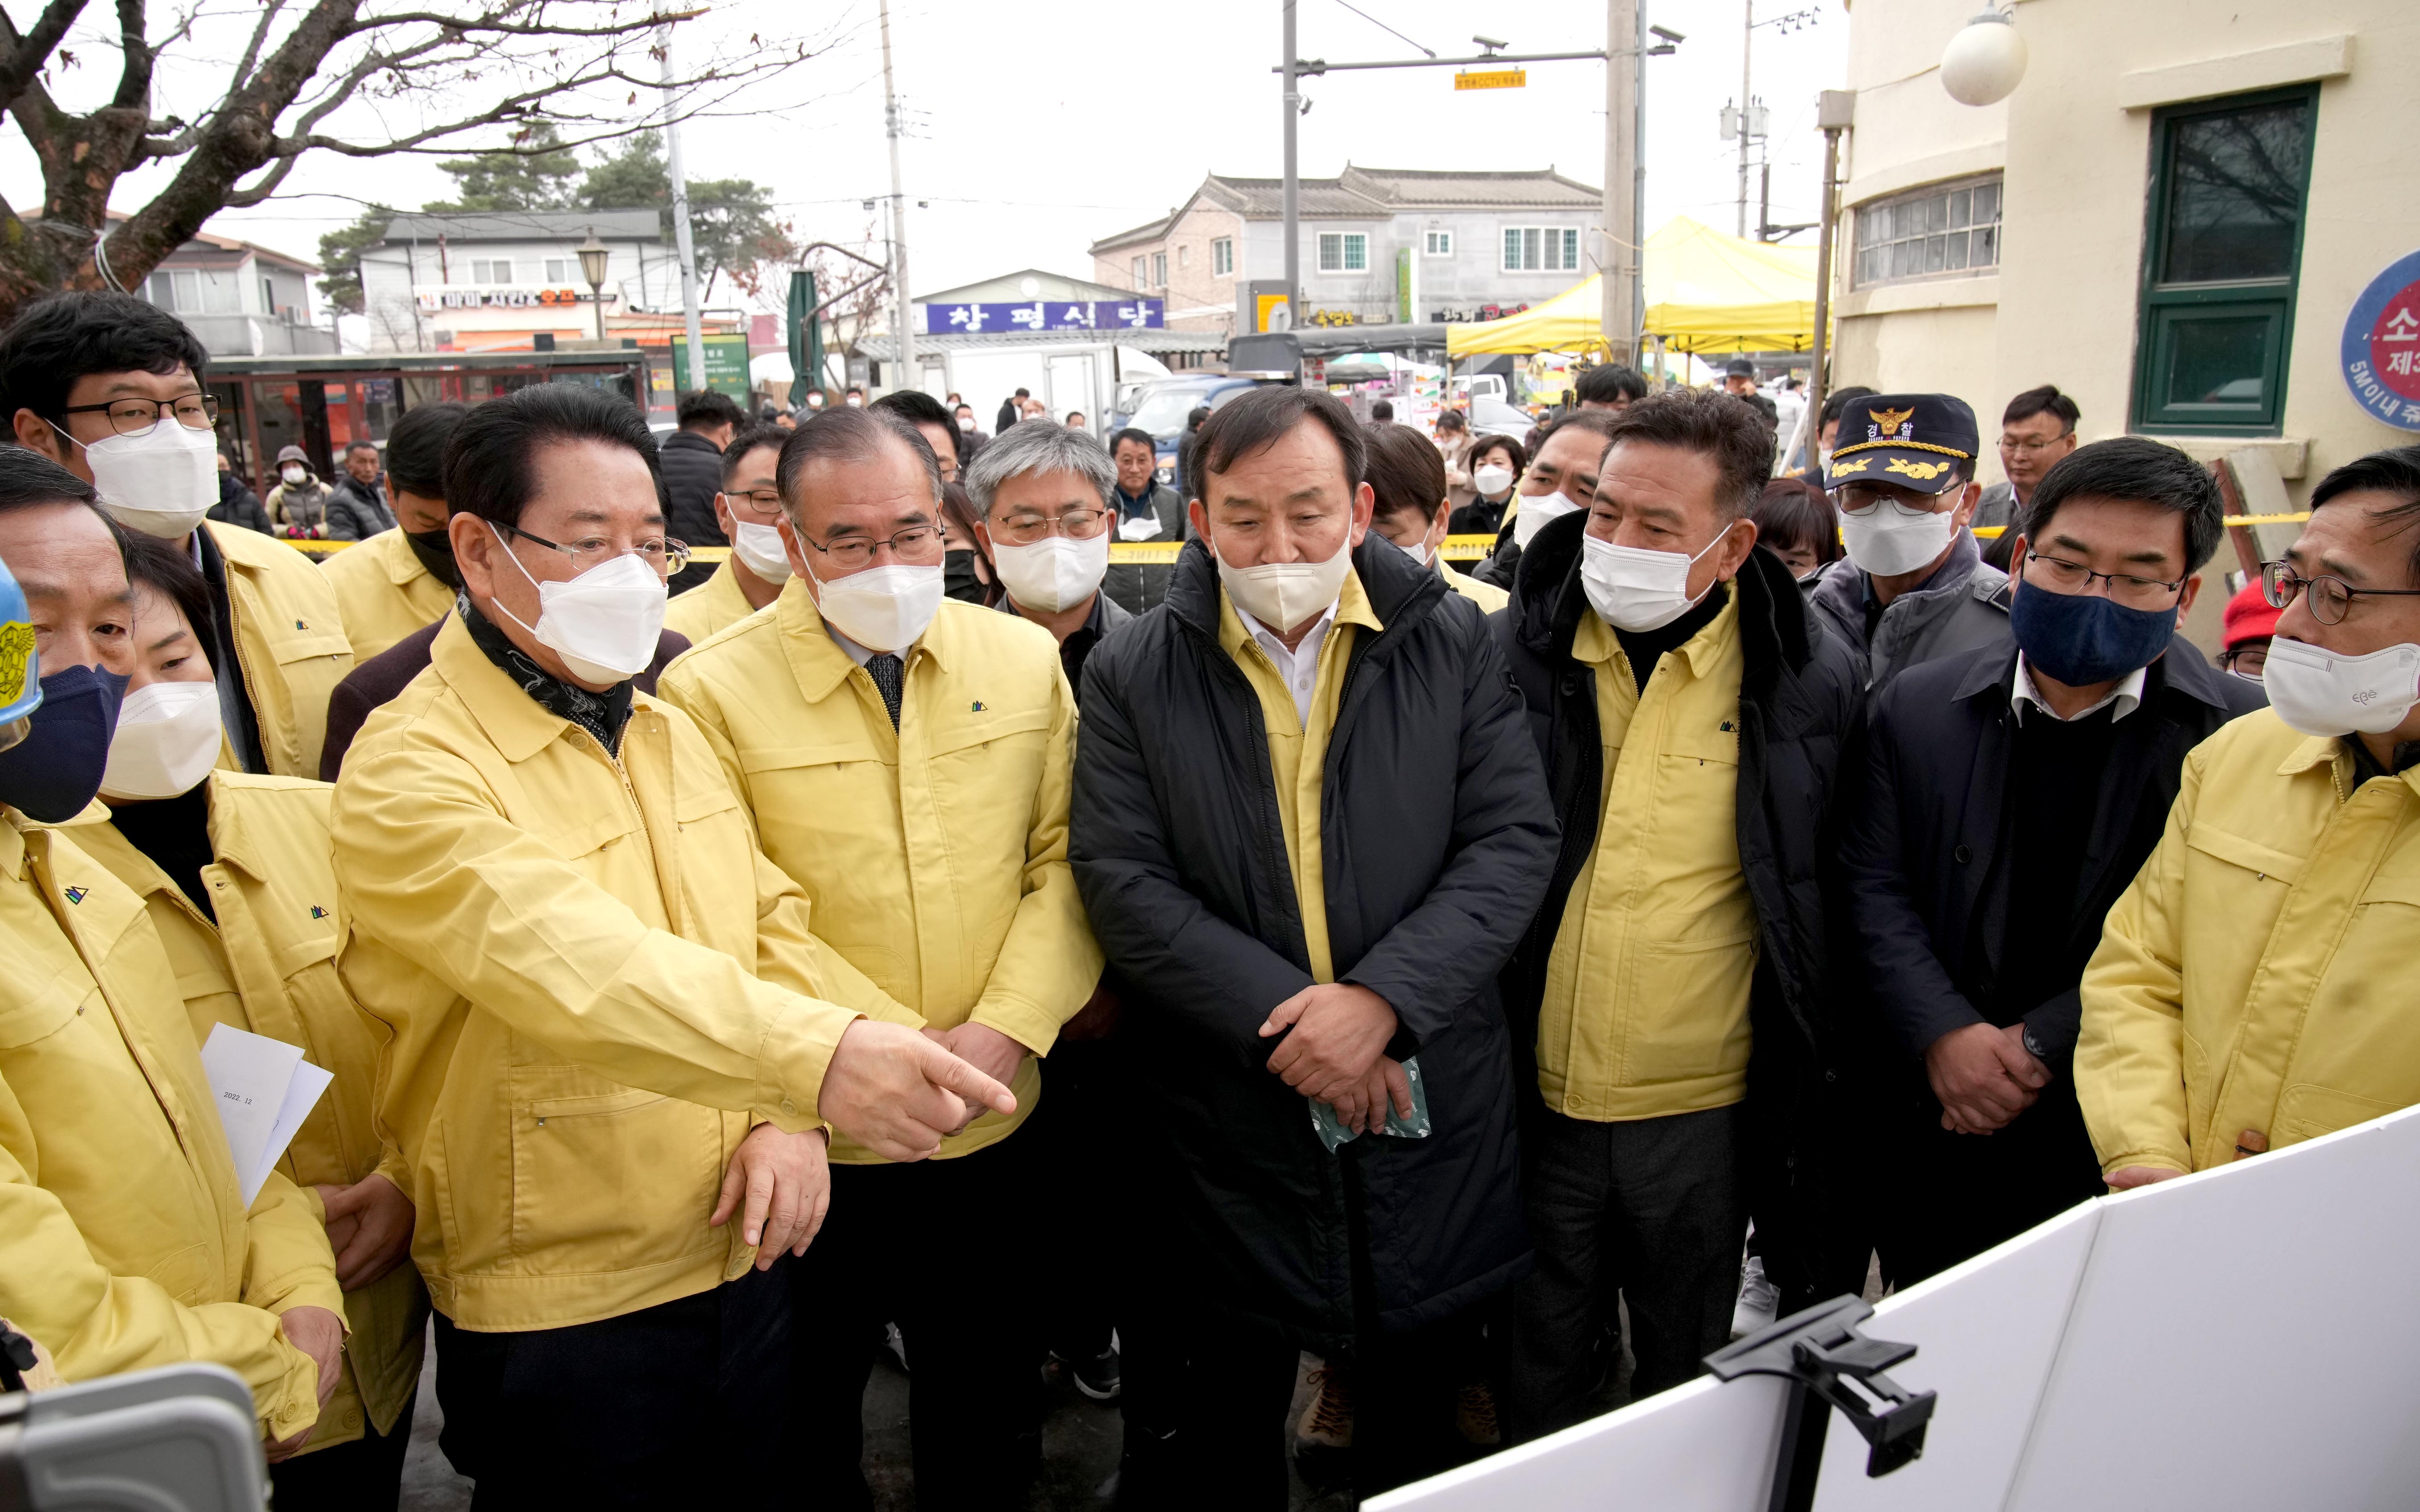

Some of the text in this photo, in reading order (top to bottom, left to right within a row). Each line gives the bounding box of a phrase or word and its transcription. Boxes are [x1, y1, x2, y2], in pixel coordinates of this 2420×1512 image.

[445, 291, 482, 310] 마미
[1317, 308, 1355, 329] 흑염소
[2350, 360, 2401, 418] 5M이내
[224, 1091, 241, 1102] 2022.
